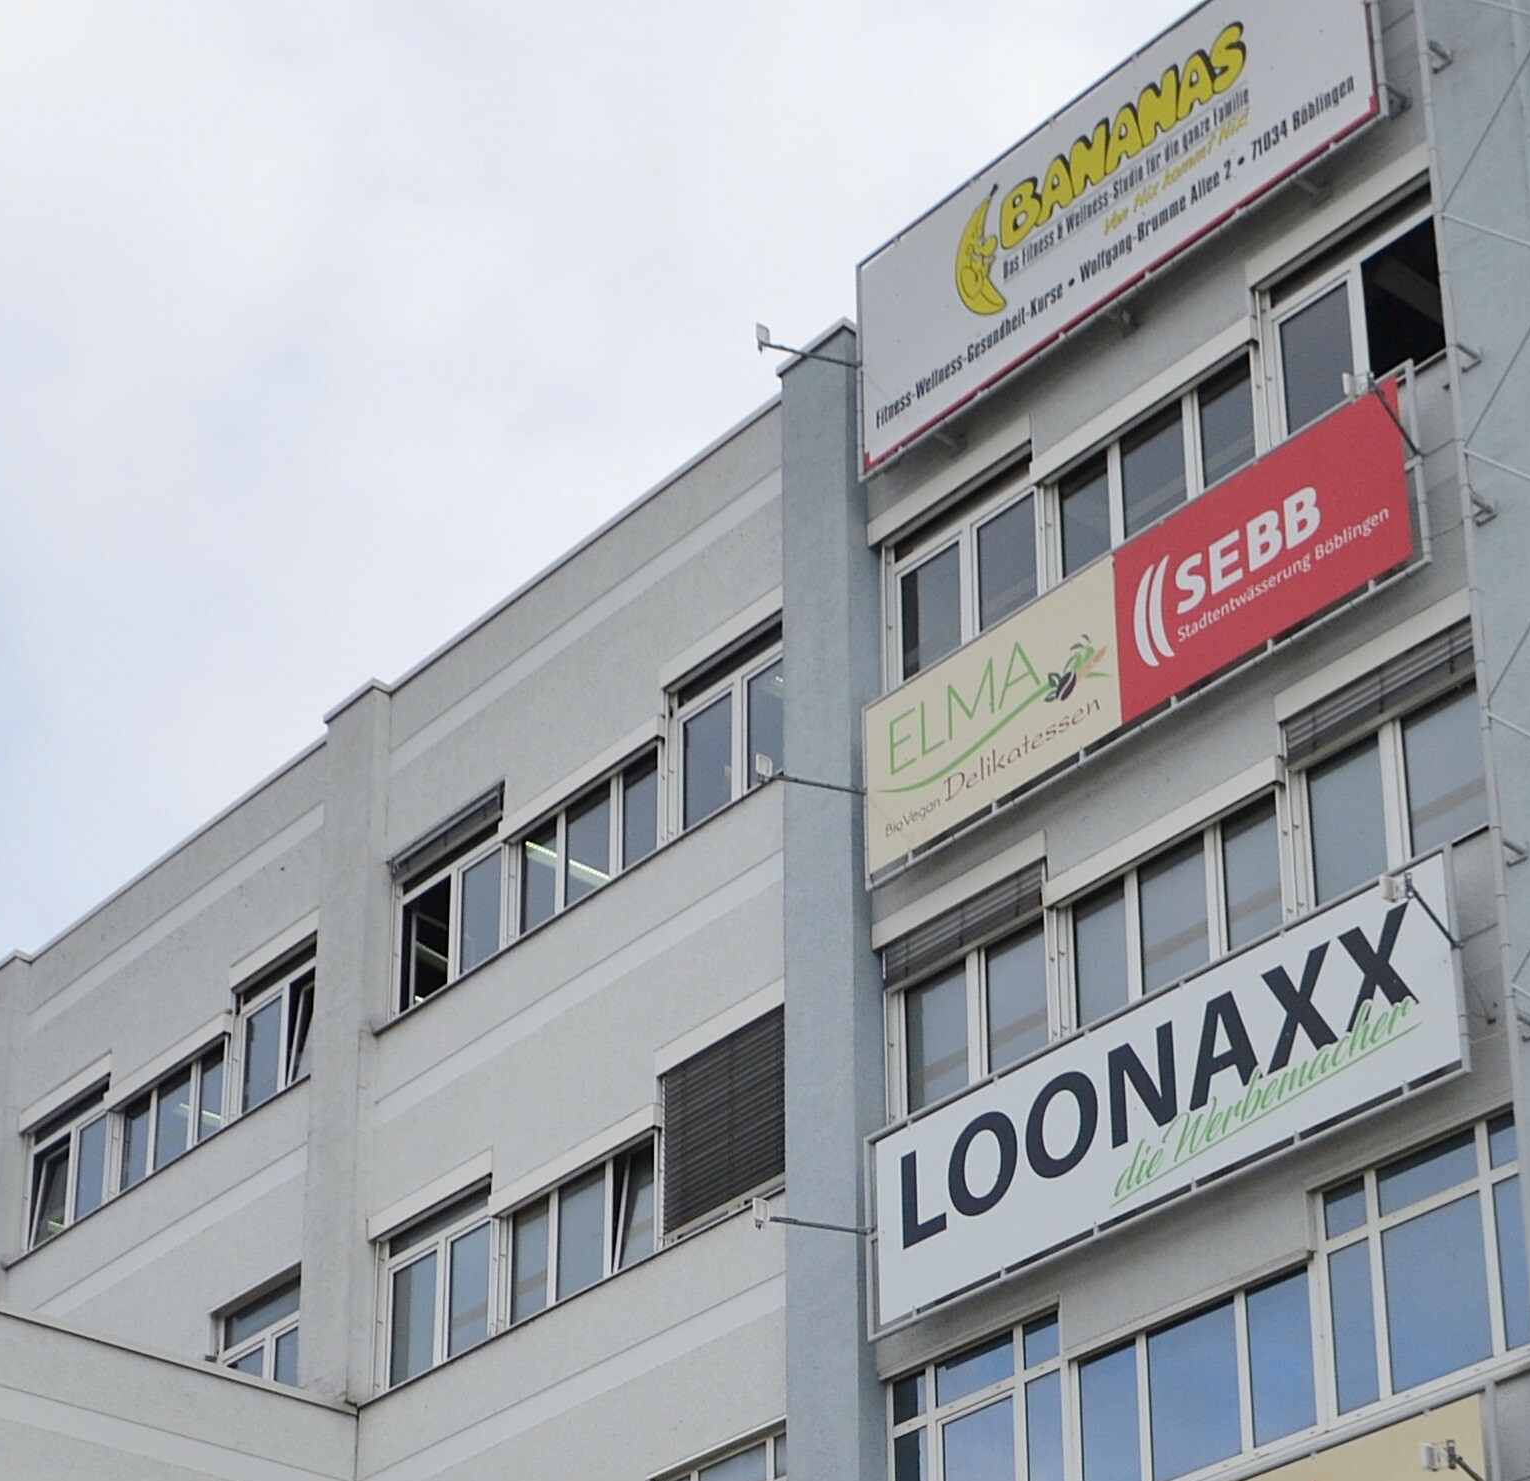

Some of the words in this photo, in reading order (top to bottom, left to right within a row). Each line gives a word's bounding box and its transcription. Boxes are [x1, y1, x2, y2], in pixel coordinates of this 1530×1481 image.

[999, 20, 1247, 251] BANANAS
[1003, 257, 1019, 280] Das
[1022, 230, 1055, 266] Fitness
[1146, 152, 1161, 175] für
[1165, 139, 1179, 163] die
[1182, 116, 1210, 151] ganze
[1213, 87, 1249, 127] Familie
[1079, 191, 1187, 285] Wolfgang-Brumme
[1190, 170, 1220, 205] Allee
[1223, 158, 1232, 181] 2
[1251, 120, 1288, 161] 71034
[1292, 75, 1355, 133] Böblingen
[1174, 487, 1321, 614] SEBB
[1177, 557, 1312, 643] Stadtentwässerung
[1315, 507, 1389, 563] Böblingen
[889, 641, 1042, 775] ELMA
[943, 699, 1101, 802] Delikatessen
[901, 903, 1420, 1250] LOONAXX
[1114, 1144, 1165, 1198] die
[1166, 998, 1413, 1171] Werbemacher
